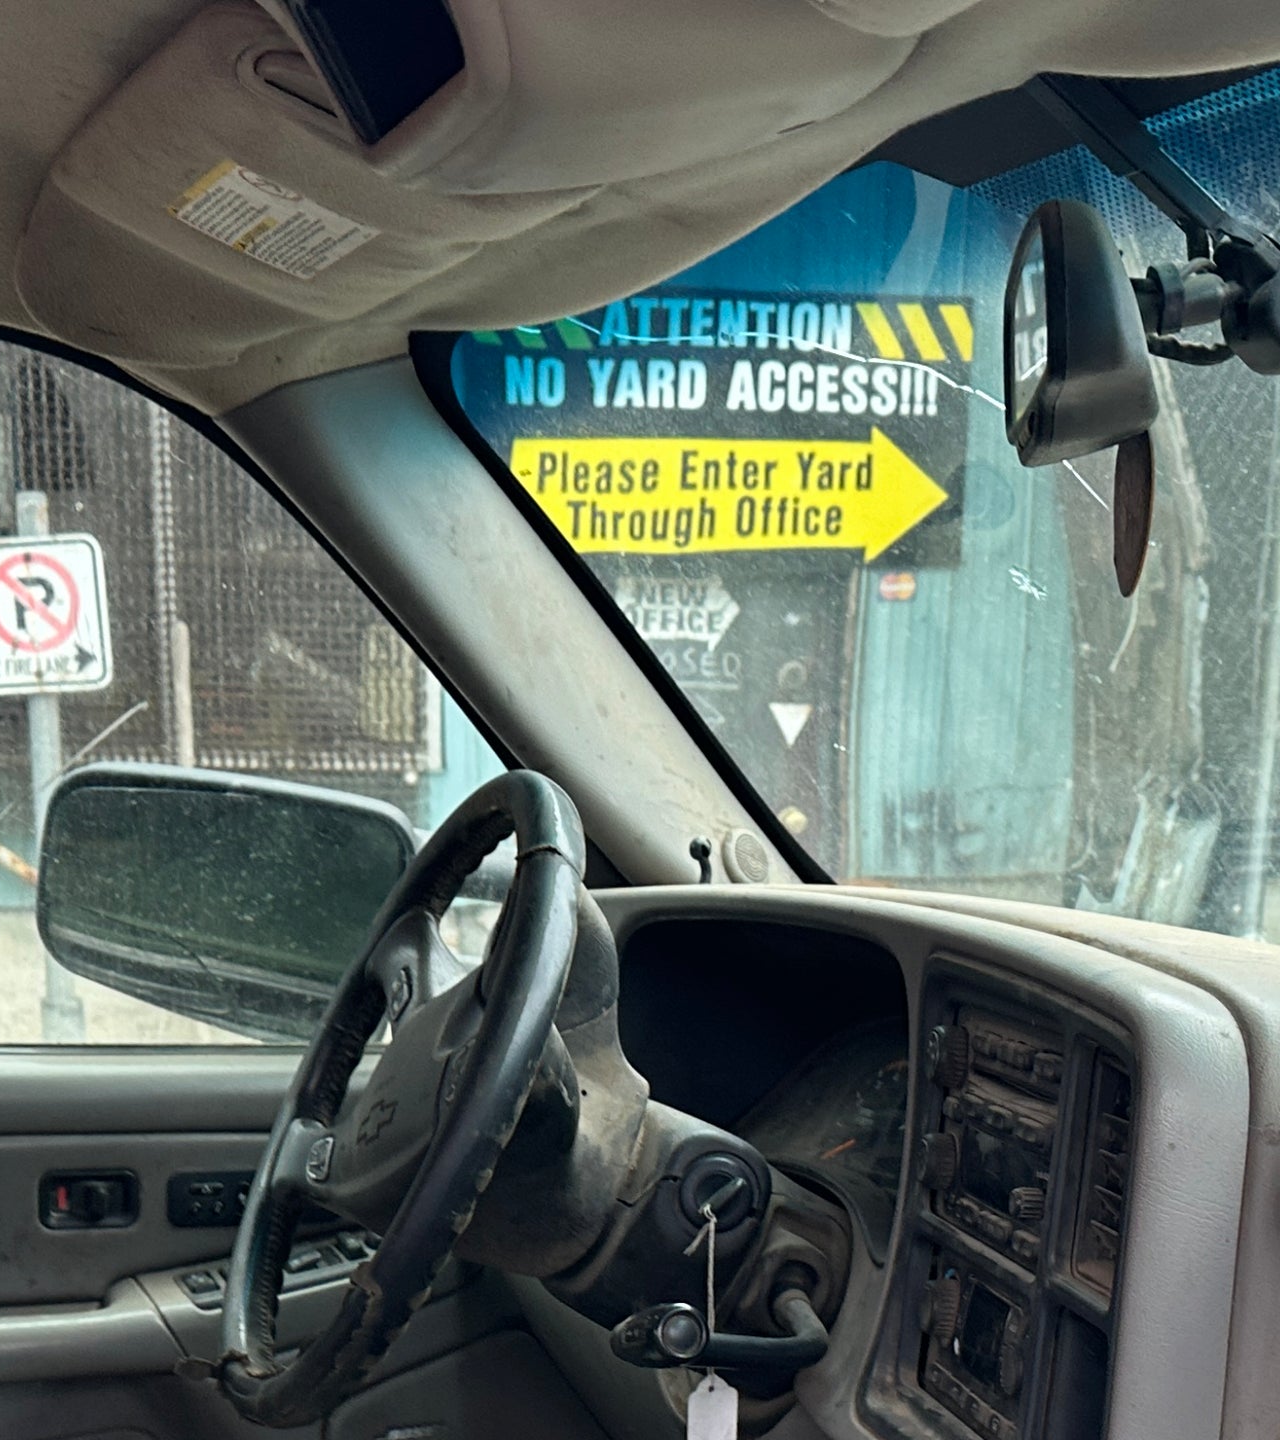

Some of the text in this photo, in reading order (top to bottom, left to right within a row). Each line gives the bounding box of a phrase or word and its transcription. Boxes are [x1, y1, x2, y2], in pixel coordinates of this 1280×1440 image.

[598, 298, 853, 347] ATTENTION
[504, 356, 939, 415] NO YARD ACCESS!!!
[536, 450, 874, 494] Please Enter Yard
[566, 496, 844, 547] Through Office
